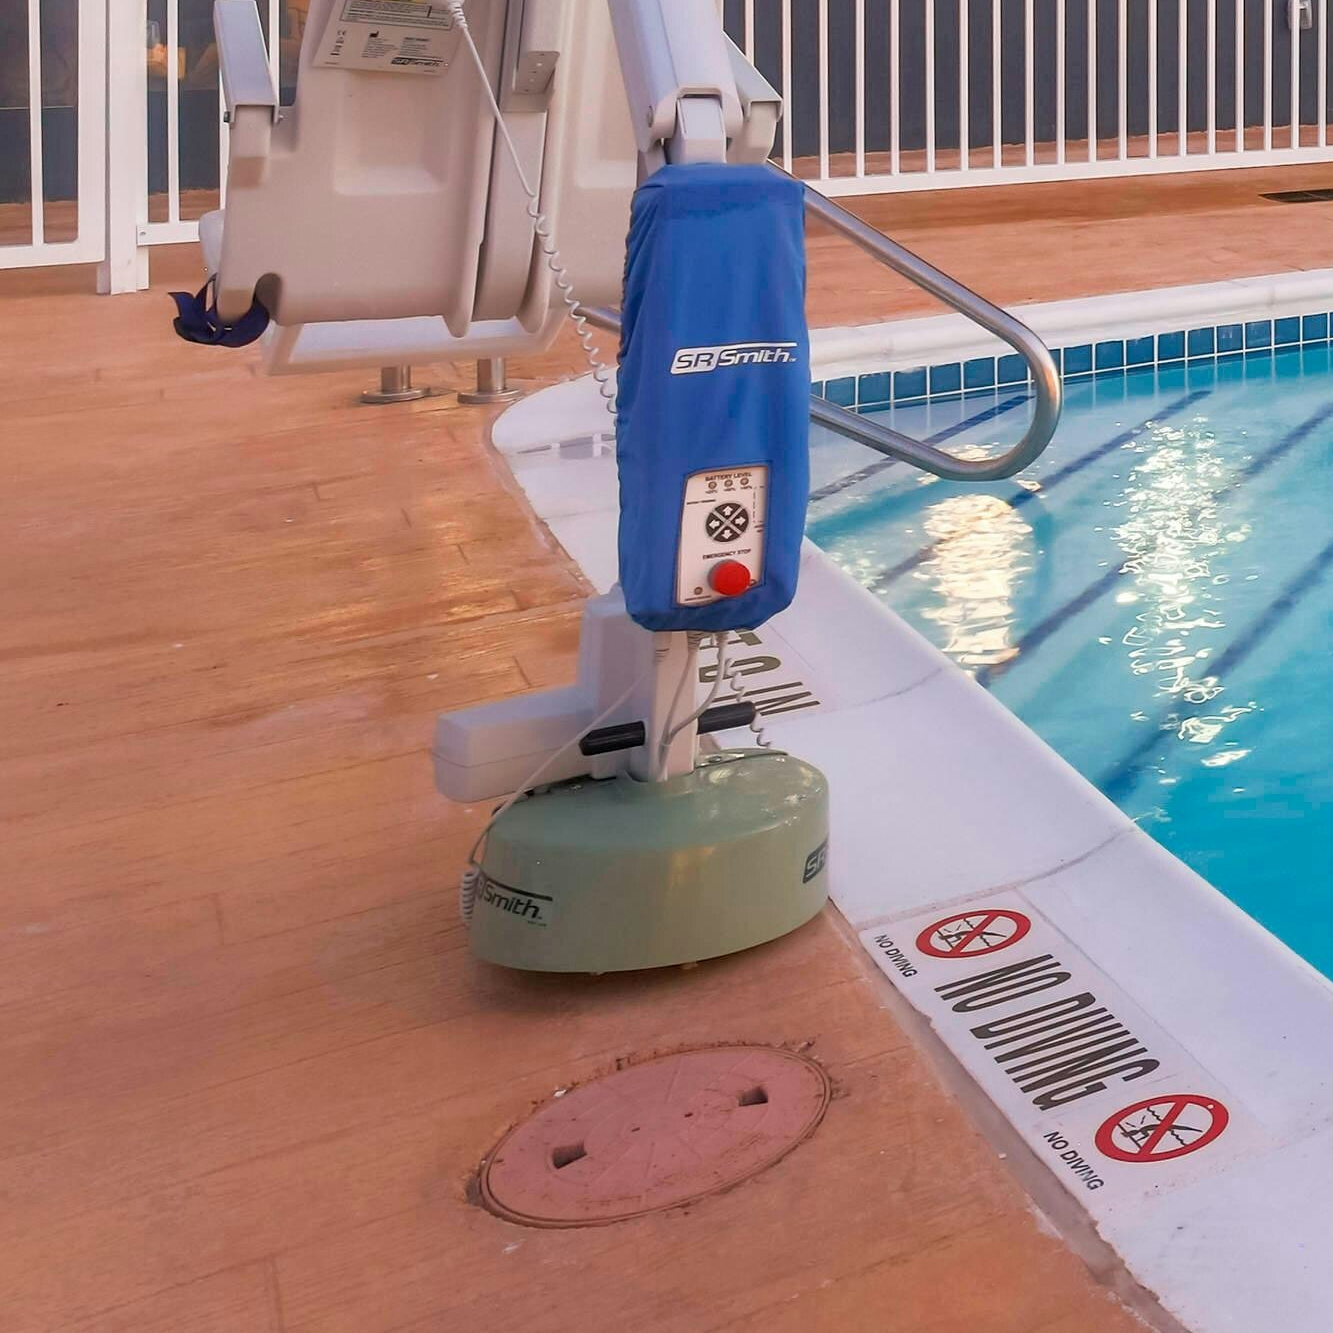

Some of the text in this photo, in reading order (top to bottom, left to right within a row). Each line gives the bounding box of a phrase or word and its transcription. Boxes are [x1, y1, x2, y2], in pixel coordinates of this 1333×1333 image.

[703, 550, 736, 559] EMERGENCY
[874, 934, 918, 978] NO DIVING
[934, 953, 1161, 1111] NO DIVING
[1043, 1130, 1105, 1191] NO DIVING
